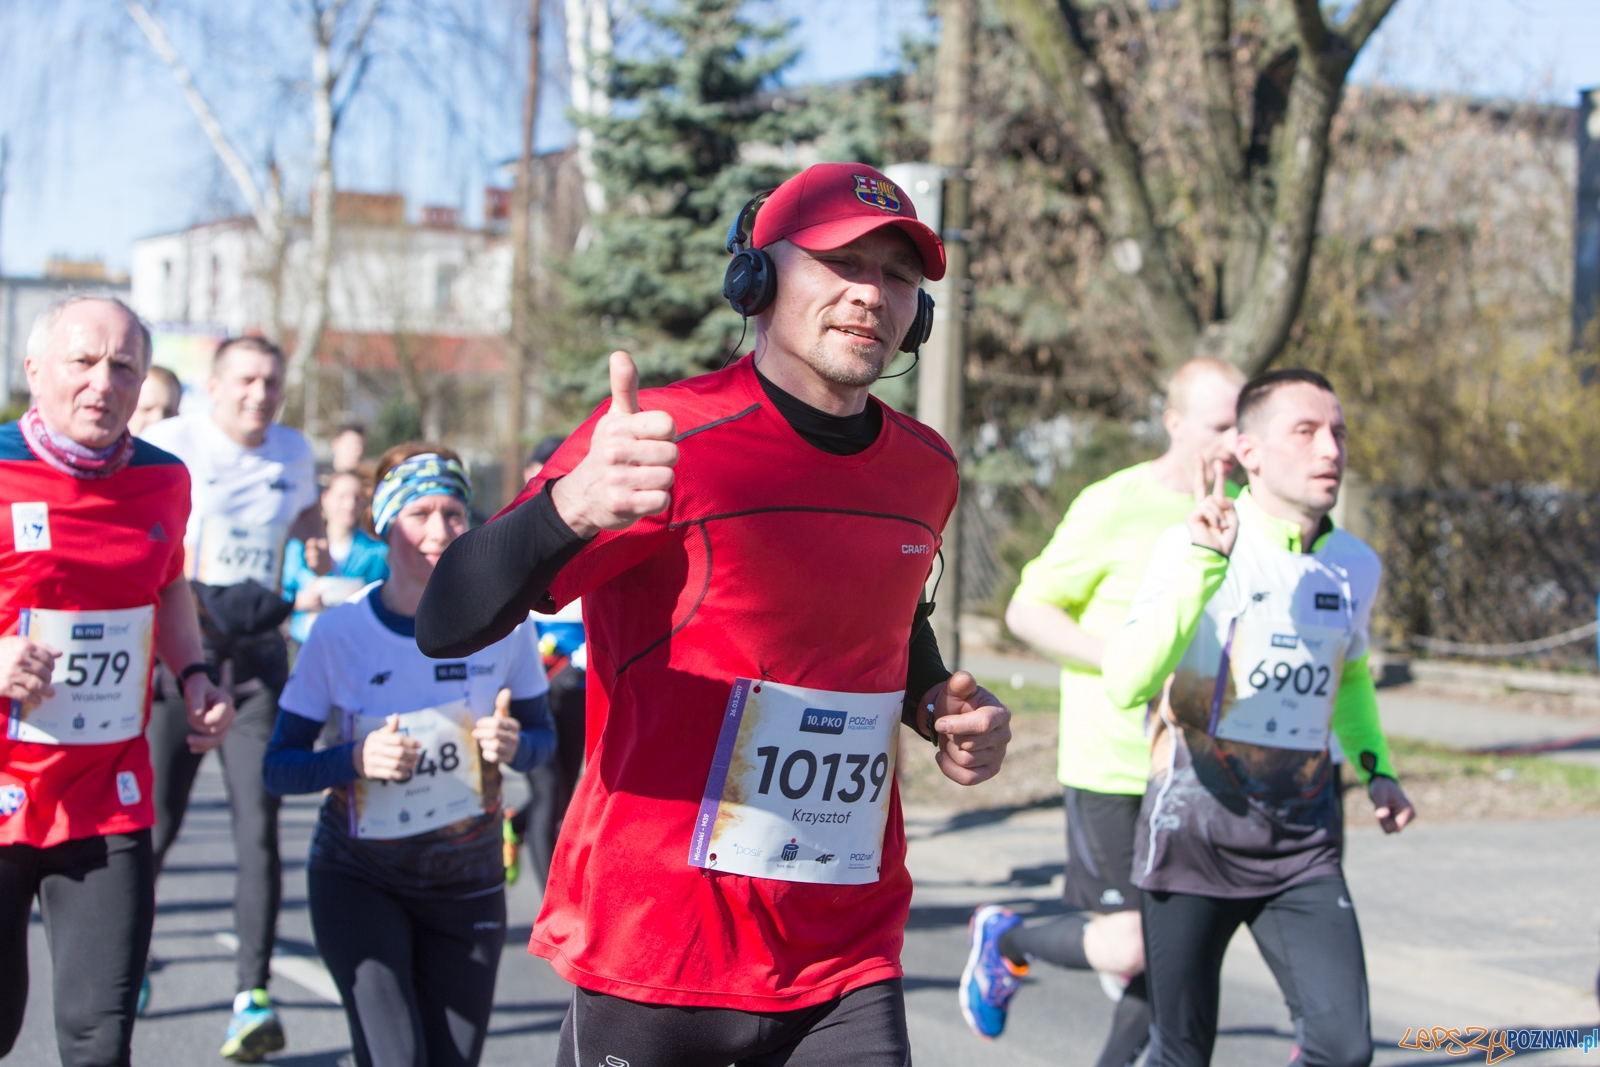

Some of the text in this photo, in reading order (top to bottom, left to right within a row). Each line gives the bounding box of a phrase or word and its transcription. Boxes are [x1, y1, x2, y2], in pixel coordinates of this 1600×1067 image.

[901, 544, 927, 555] CRAFT
[1249, 659, 1331, 697] 6902
[729, 685, 743, 717] 26.03.2017
[806, 715, 843, 728] 10. PKO
[757, 745, 889, 803] 10139
[701, 813, 710, 828] M39
[791, 808, 852, 826] Krzysztof
[814, 853, 835, 865] 4F
